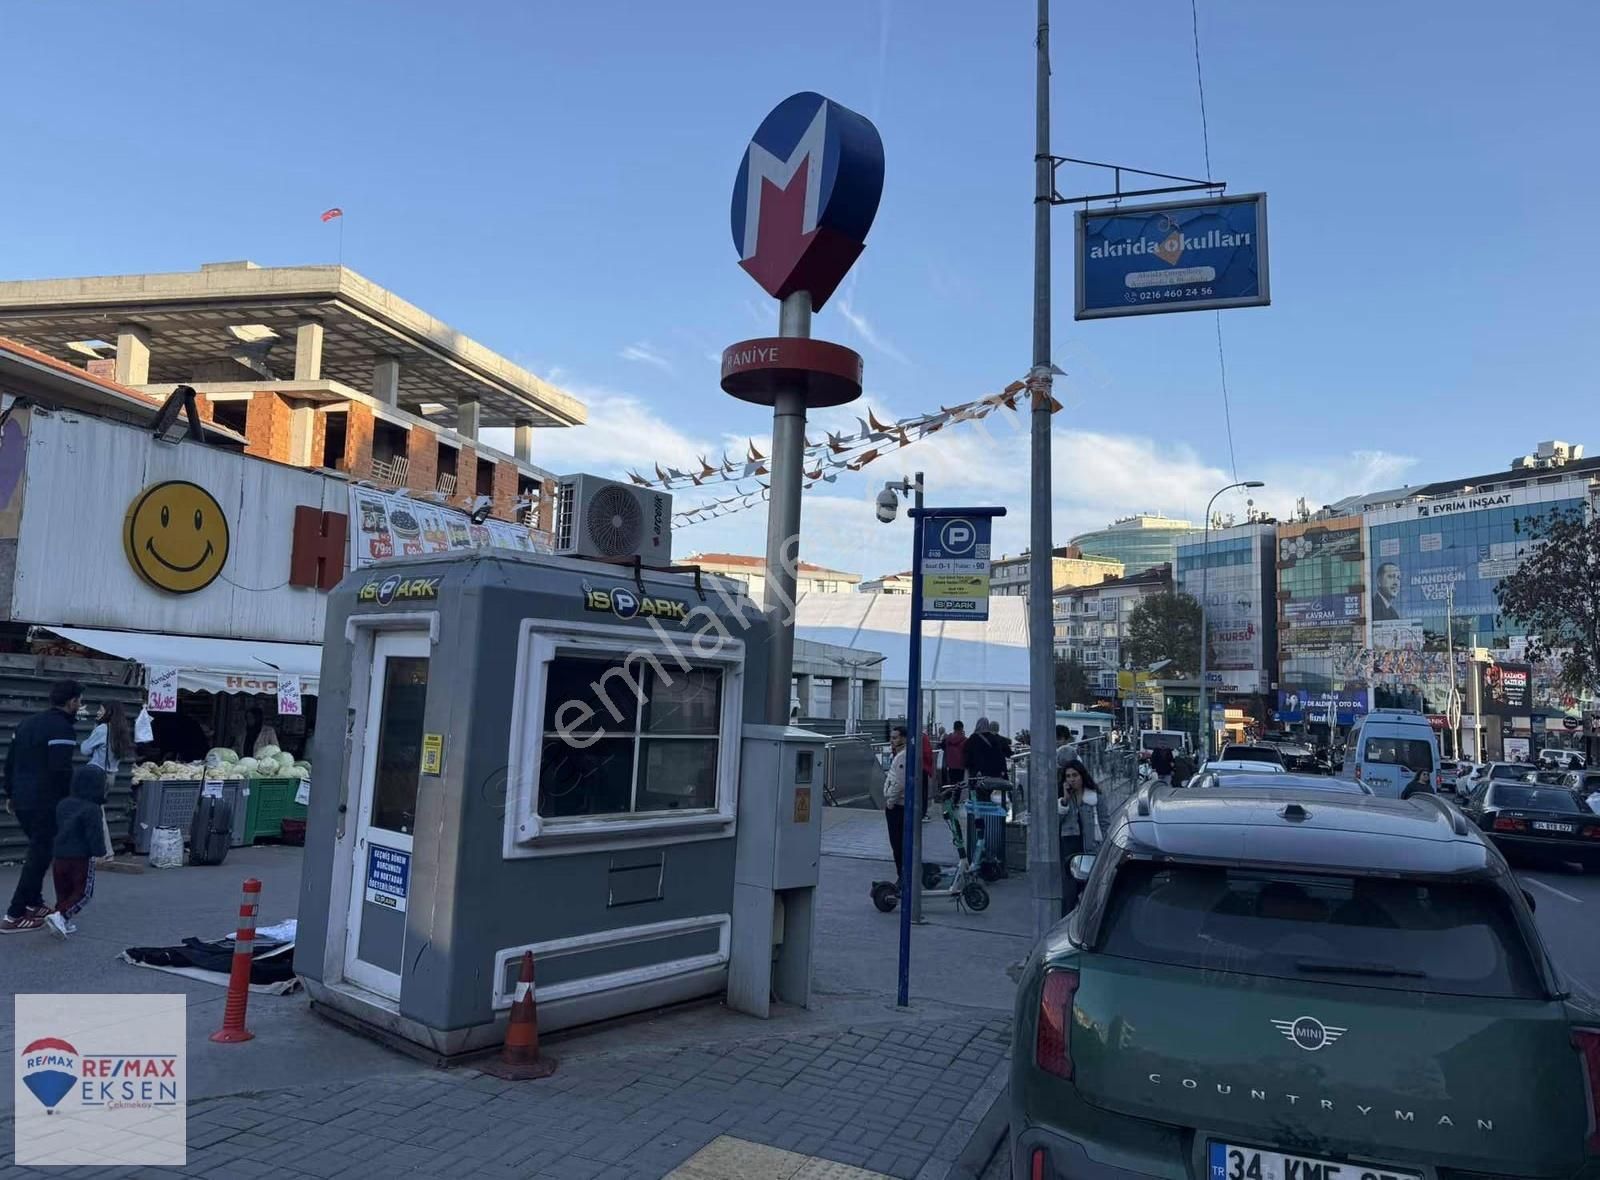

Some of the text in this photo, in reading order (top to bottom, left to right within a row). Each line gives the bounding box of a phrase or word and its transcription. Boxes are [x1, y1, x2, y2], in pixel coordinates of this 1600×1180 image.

[1090, 237, 1159, 259] akrida
[1139, 286, 1213, 301] 0216 460 24 56
[948, 527, 970, 546] P
[1297, 1027, 1322, 1040] MINI
[1148, 1073, 1493, 1131] COUNTRYMAN
[1211, 1165, 1225, 1176] TR
